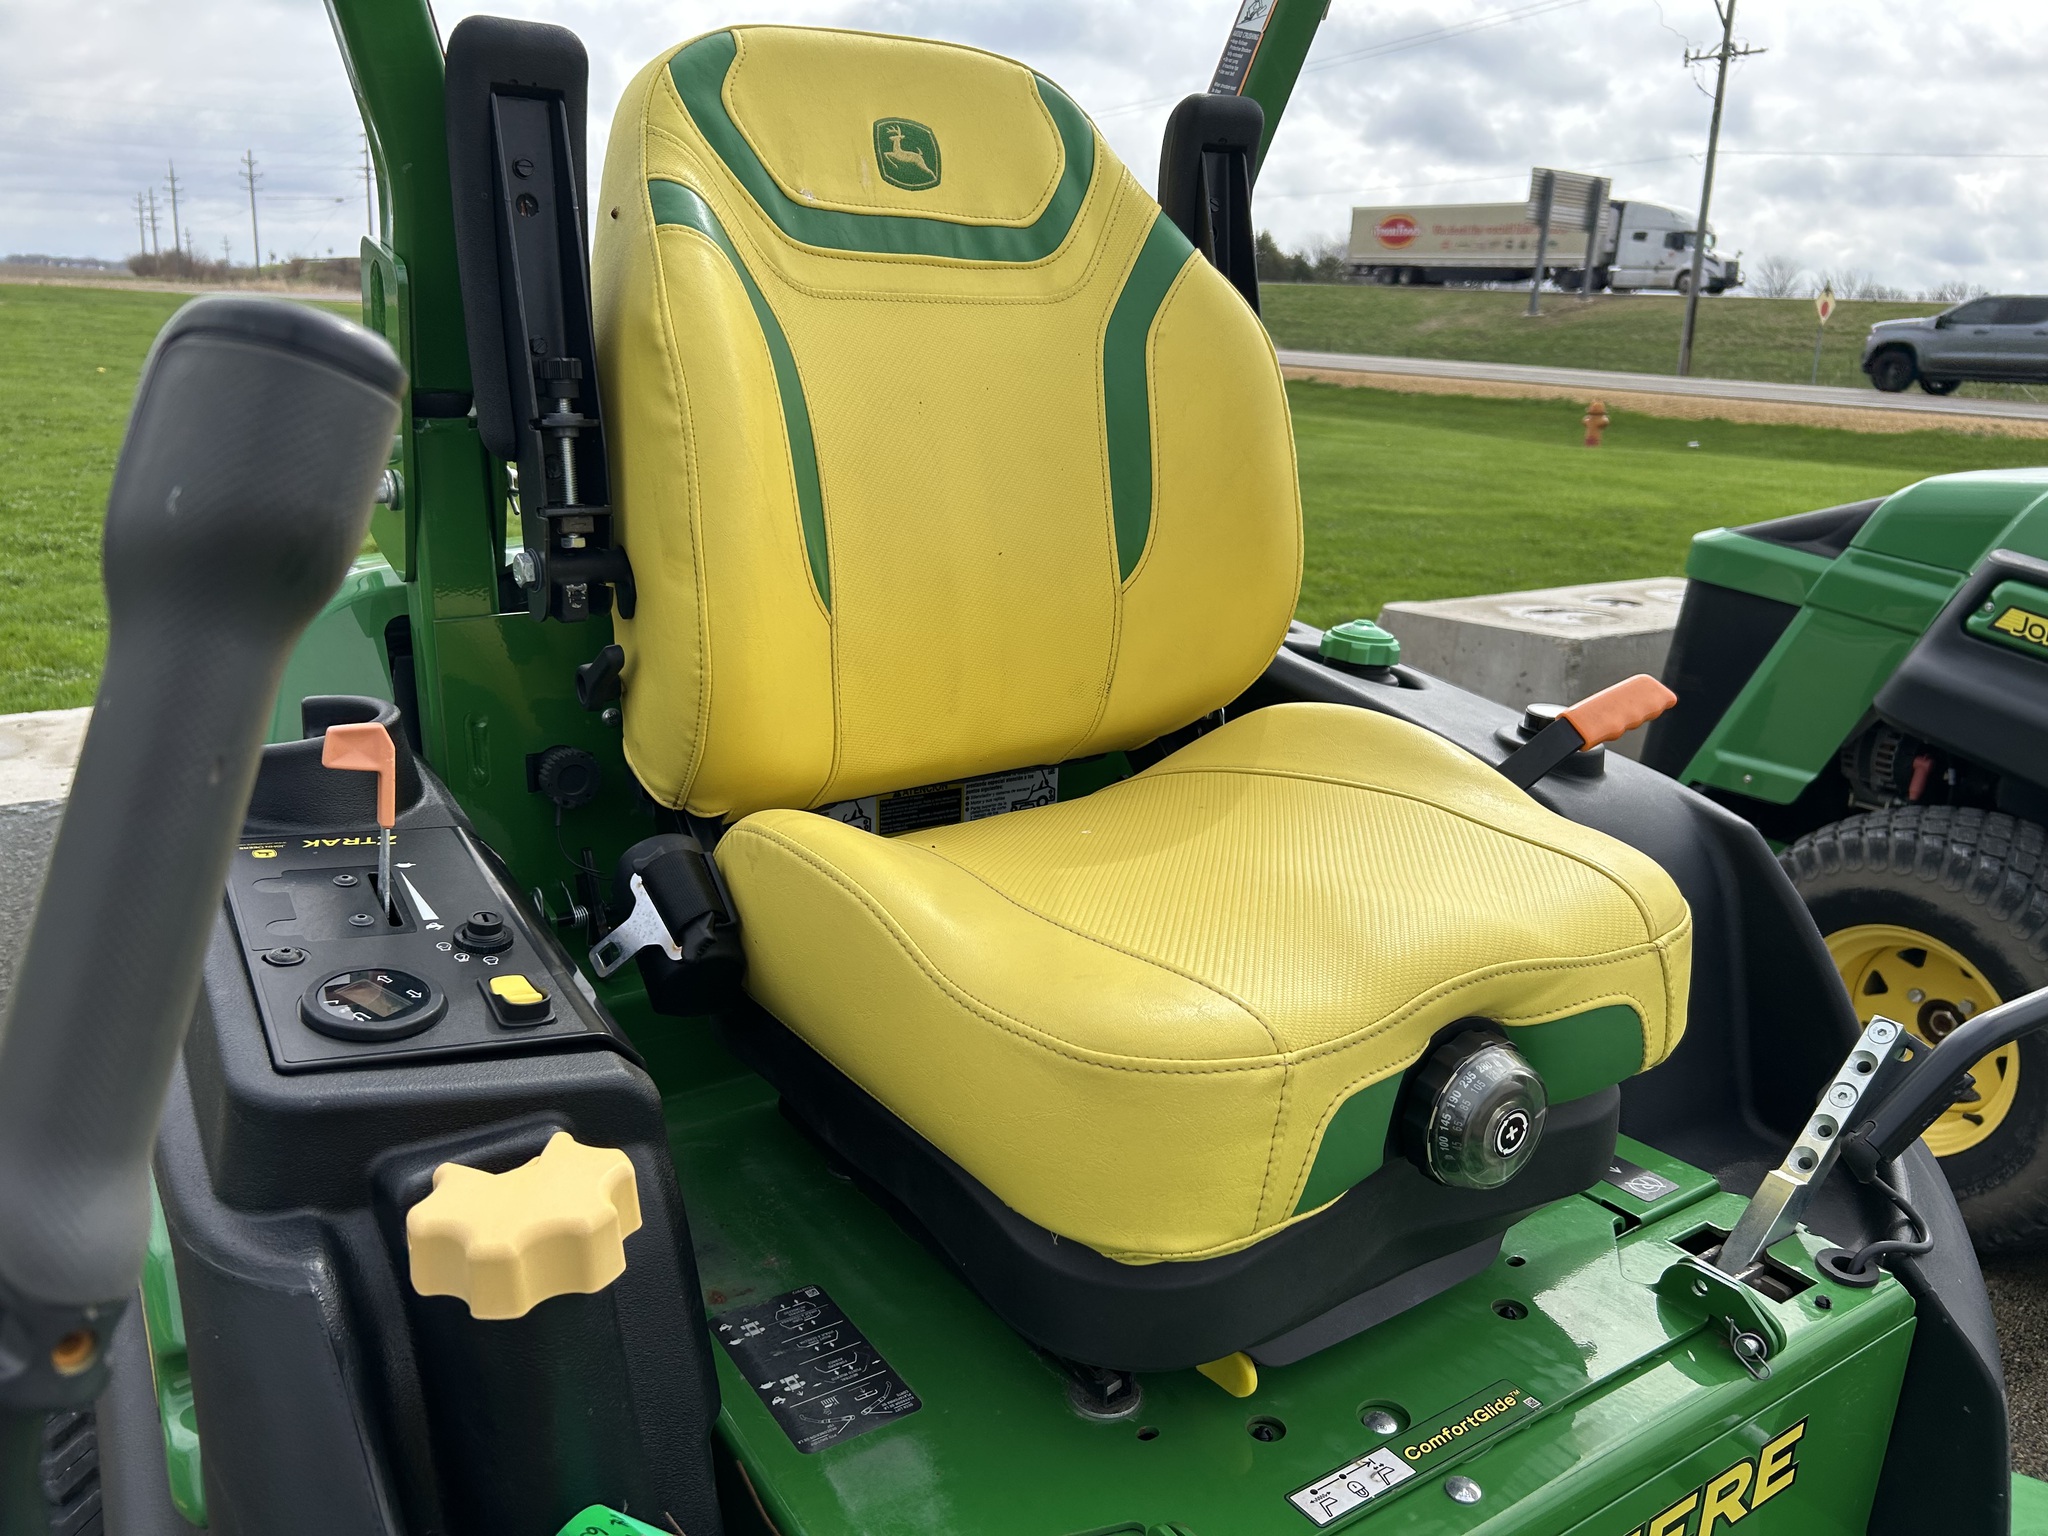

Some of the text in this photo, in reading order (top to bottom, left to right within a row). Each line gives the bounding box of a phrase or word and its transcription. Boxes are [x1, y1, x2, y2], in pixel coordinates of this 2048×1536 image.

[2011, 615, 2048, 643] JO
[1440, 1113, 1451, 1130] 145
[1447, 1090, 1461, 1108] 190
[1459, 1071, 1476, 1088] 235
[1453, 1120, 1463, 1131] 65
[1460, 1099, 1471, 1110] 85
[1470, 1080, 1486, 1093] 105
